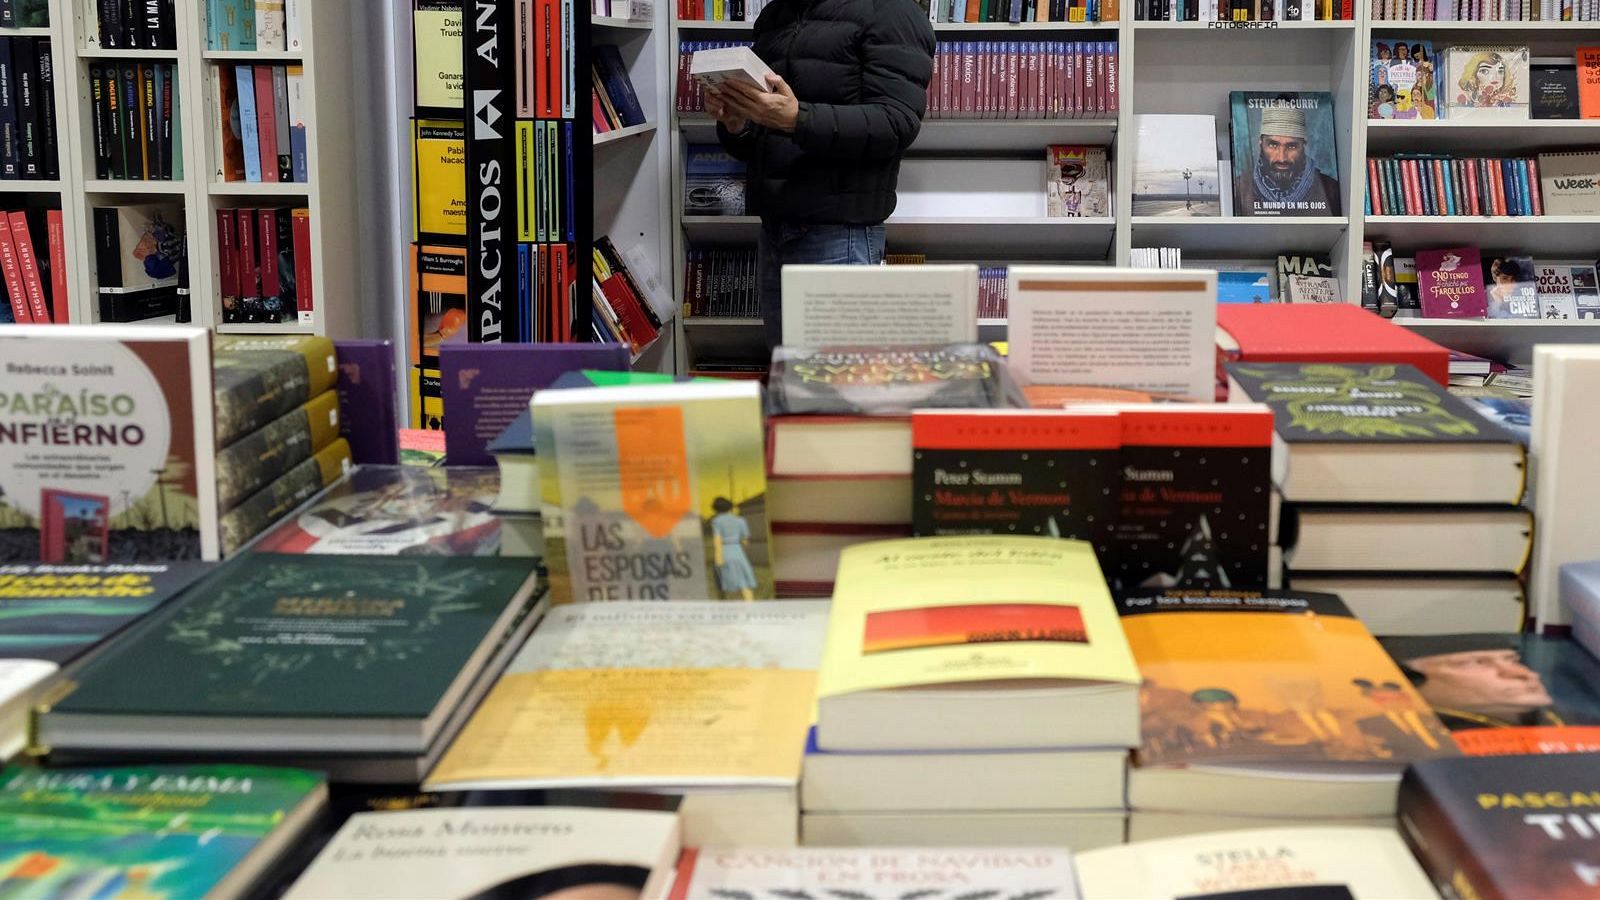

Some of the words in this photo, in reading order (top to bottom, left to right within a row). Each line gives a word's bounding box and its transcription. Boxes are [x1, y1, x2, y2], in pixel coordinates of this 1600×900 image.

[147, 17, 159, 28] LA
[475, 0, 498, 68] AN
[965, 55, 973, 83] México
[1249, 99, 1275, 109] STEVE
[1279, 99, 1319, 109] McCURRY
[433, 129, 453, 138] Kennedy
[2, 242, 13, 270] HARRY
[20, 242, 32, 270] HARRY
[480, 159, 502, 344] PACTOS
[1432, 271, 1448, 281] NO
[12, 281, 24, 316] MEGHAN
[30, 281, 43, 316] MEGHAN
[1430, 286, 1475, 298] FAROLILLOS
[1538, 286, 1571, 294] ALABRAS
[1510, 302, 1537, 314] CINE
[6, 363, 67, 375] Rebecca
[72, 364, 114, 376] Solnit
[934, 469, 968, 486] Peter
[581, 523, 625, 552] LAS
[584, 552, 692, 582] ESPOSAS
